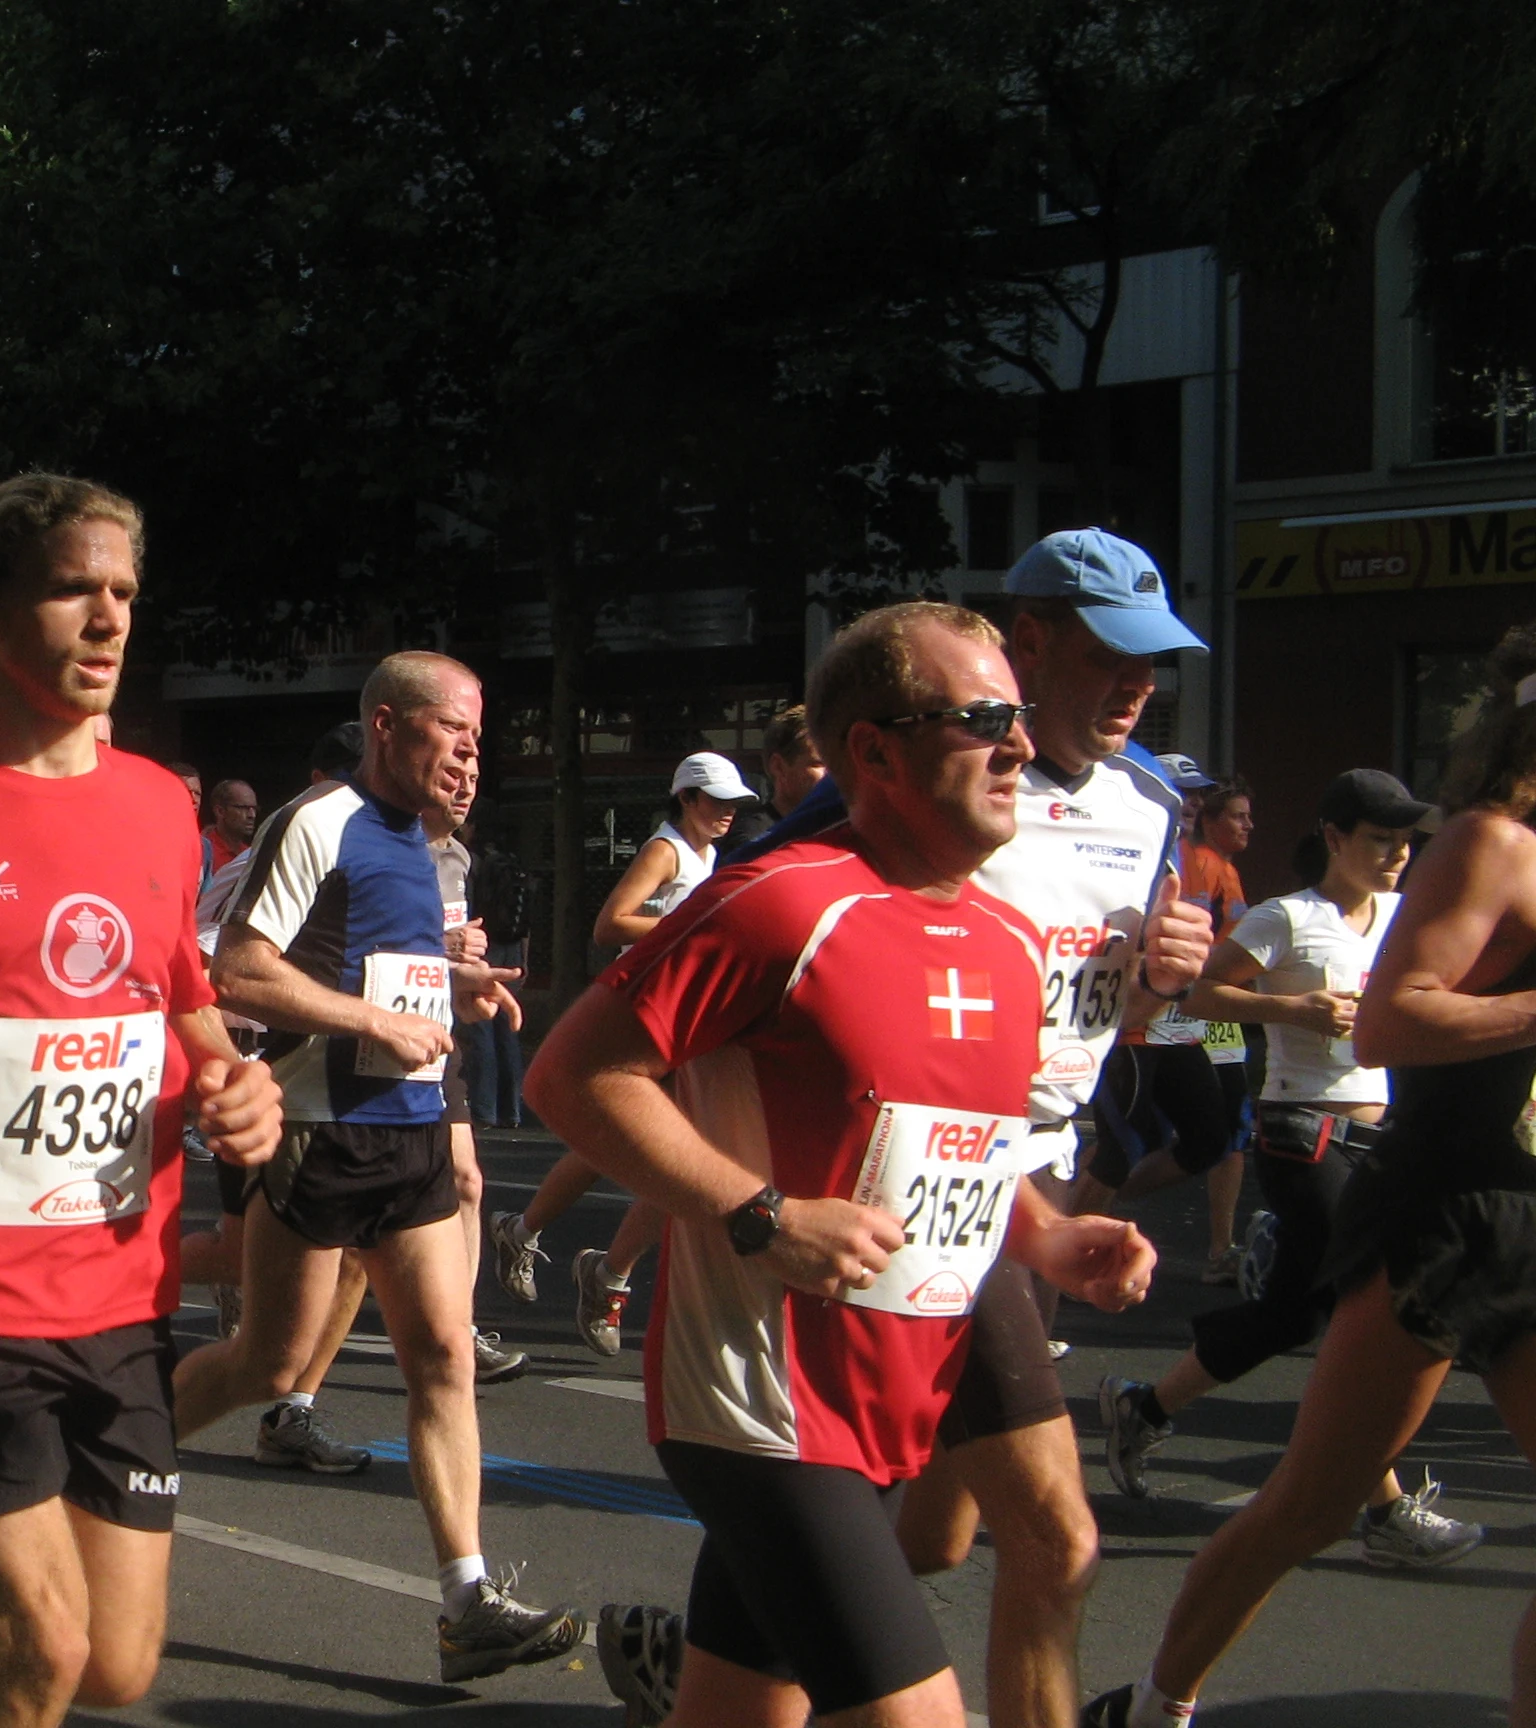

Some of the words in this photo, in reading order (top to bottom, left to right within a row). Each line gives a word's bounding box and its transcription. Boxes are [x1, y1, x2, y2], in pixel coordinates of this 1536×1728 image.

[1340, 556, 1406, 579] MFO
[1085, 844, 1142, 860] INTERSPORT
[3, 1078, 143, 1157] 4338
[68, 1159, 99, 1171] Tobias
[50, 1195, 115, 1214] Takeda
[904, 1174, 1004, 1247] 21524
[924, 1287, 965, 1304] Takeda
